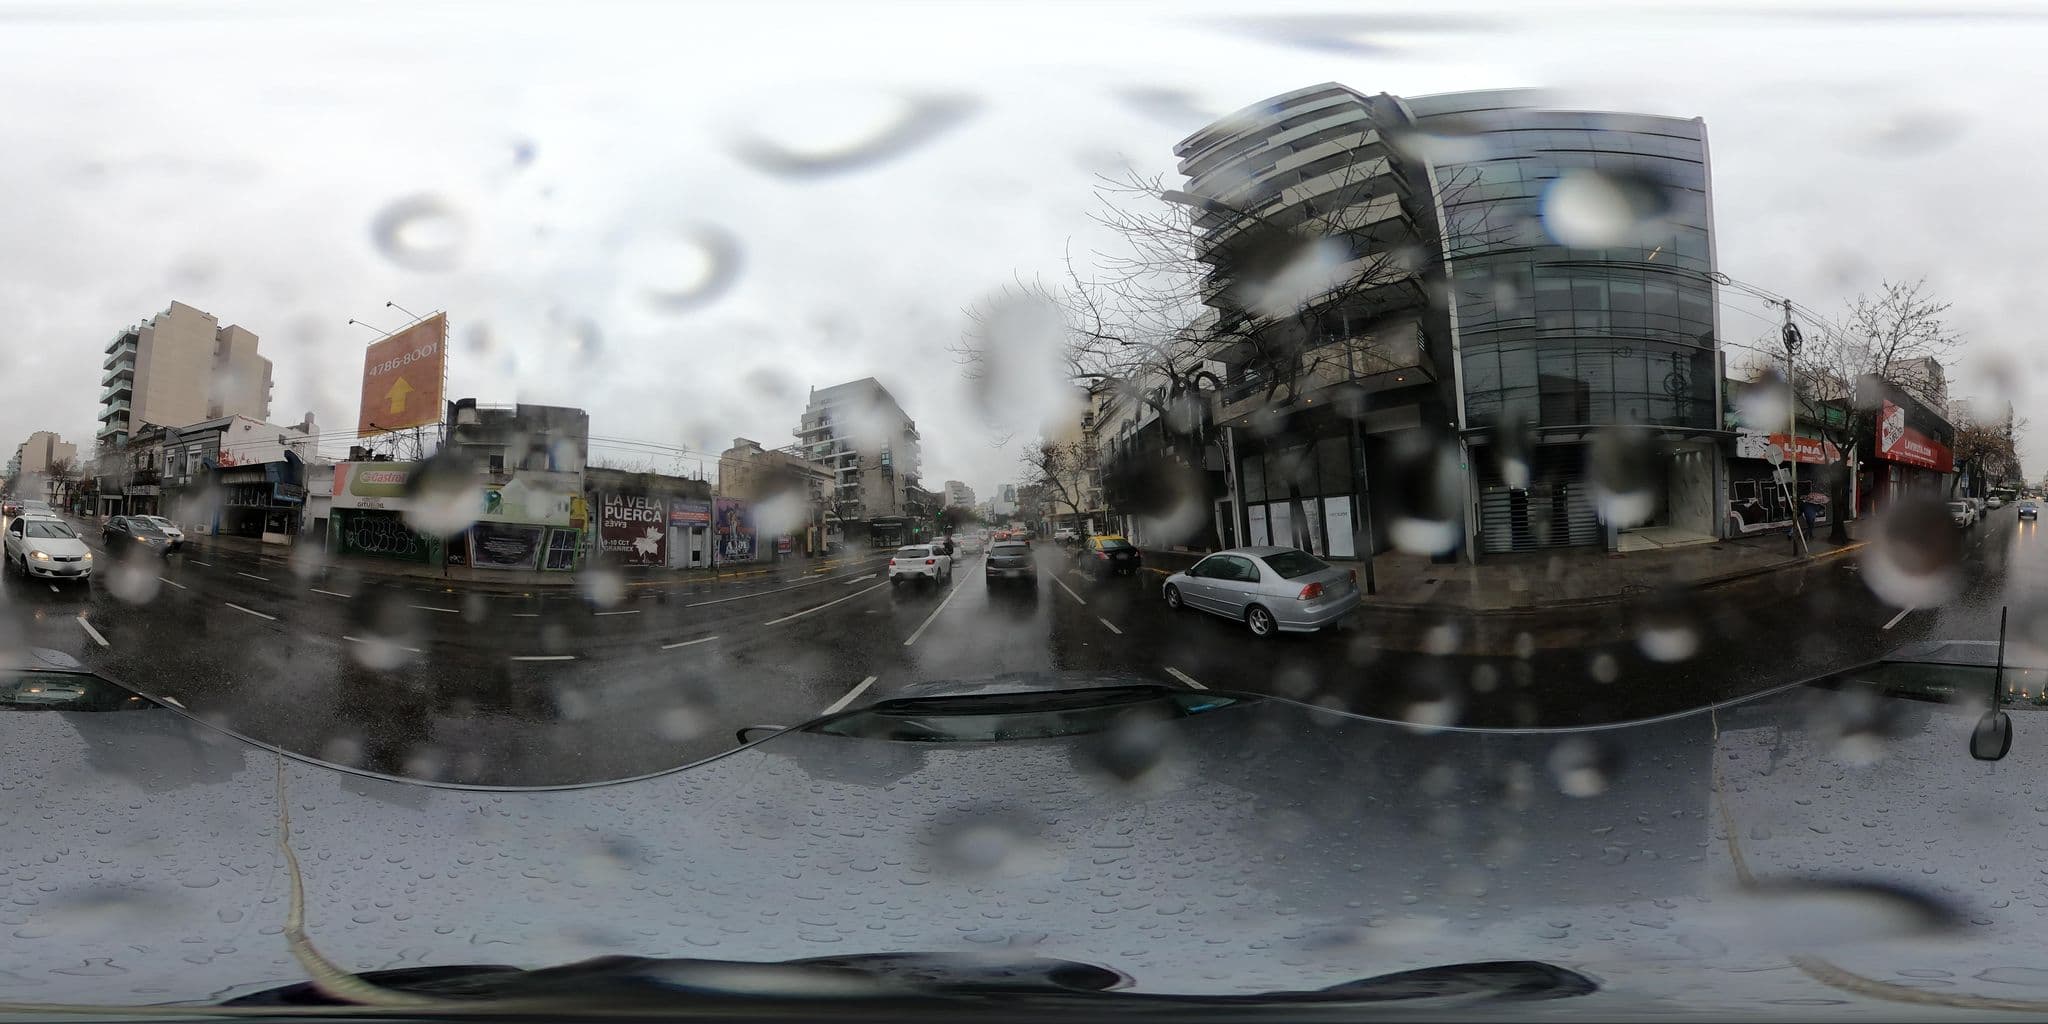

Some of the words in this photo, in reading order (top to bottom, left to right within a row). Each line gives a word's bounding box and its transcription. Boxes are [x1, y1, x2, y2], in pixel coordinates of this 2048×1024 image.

[369, 343, 438, 376] 4786-8001
[1784, 442, 1821, 455] LUNA
[605, 494, 623, 506] LA
[627, 496, 662, 510] VELA
[605, 507, 662, 523] PUERCA
